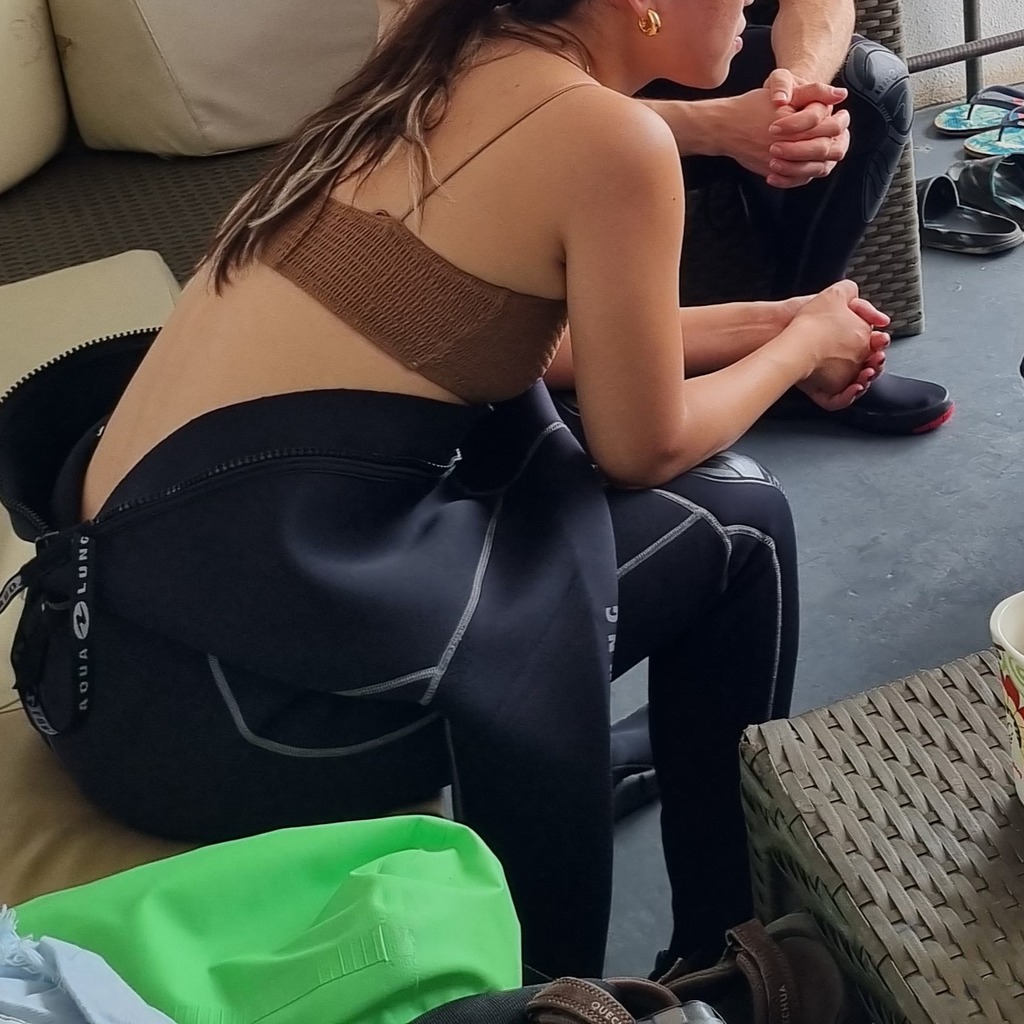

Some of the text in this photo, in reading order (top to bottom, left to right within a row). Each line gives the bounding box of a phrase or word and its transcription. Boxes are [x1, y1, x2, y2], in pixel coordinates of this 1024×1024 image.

[76, 535, 91, 711] AQUA LUNG
[591, 1001, 623, 1024] QUEC
